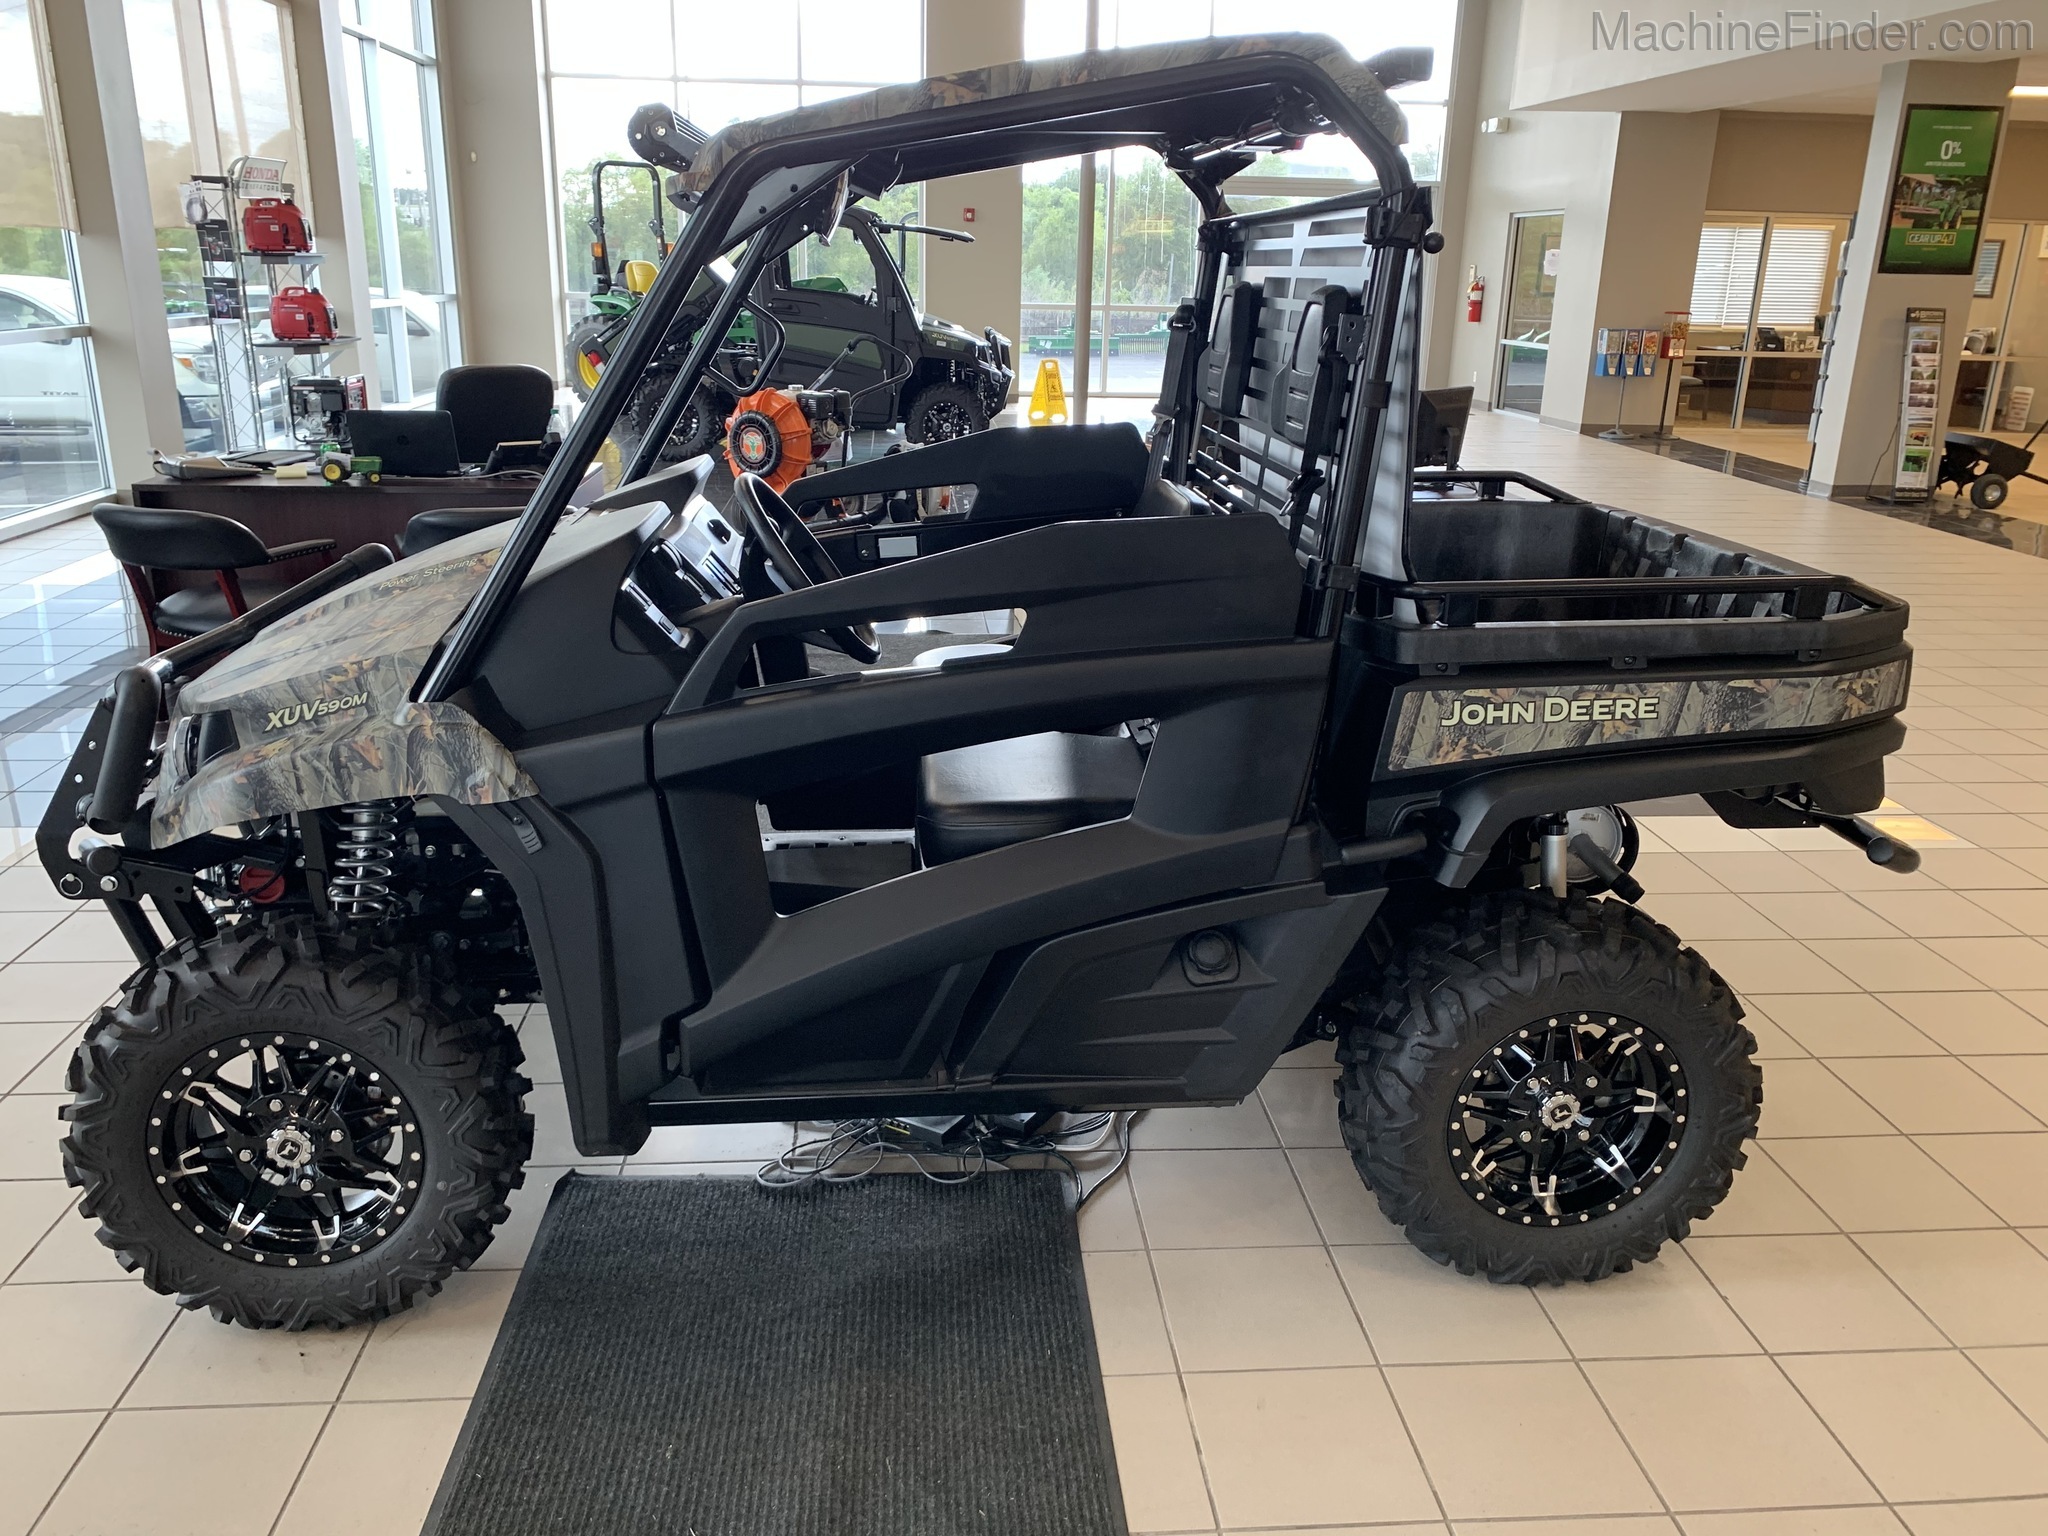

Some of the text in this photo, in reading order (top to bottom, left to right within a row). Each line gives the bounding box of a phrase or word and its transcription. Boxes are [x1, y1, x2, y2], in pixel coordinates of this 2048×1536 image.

[1940, 140, 1962, 160] 0%
[243, 166, 279, 181] HONDA
[379, 558, 478, 590] Power Steering
[263, 691, 368, 732] XUV590M
[1440, 696, 1660, 727] JOHN DEERE
